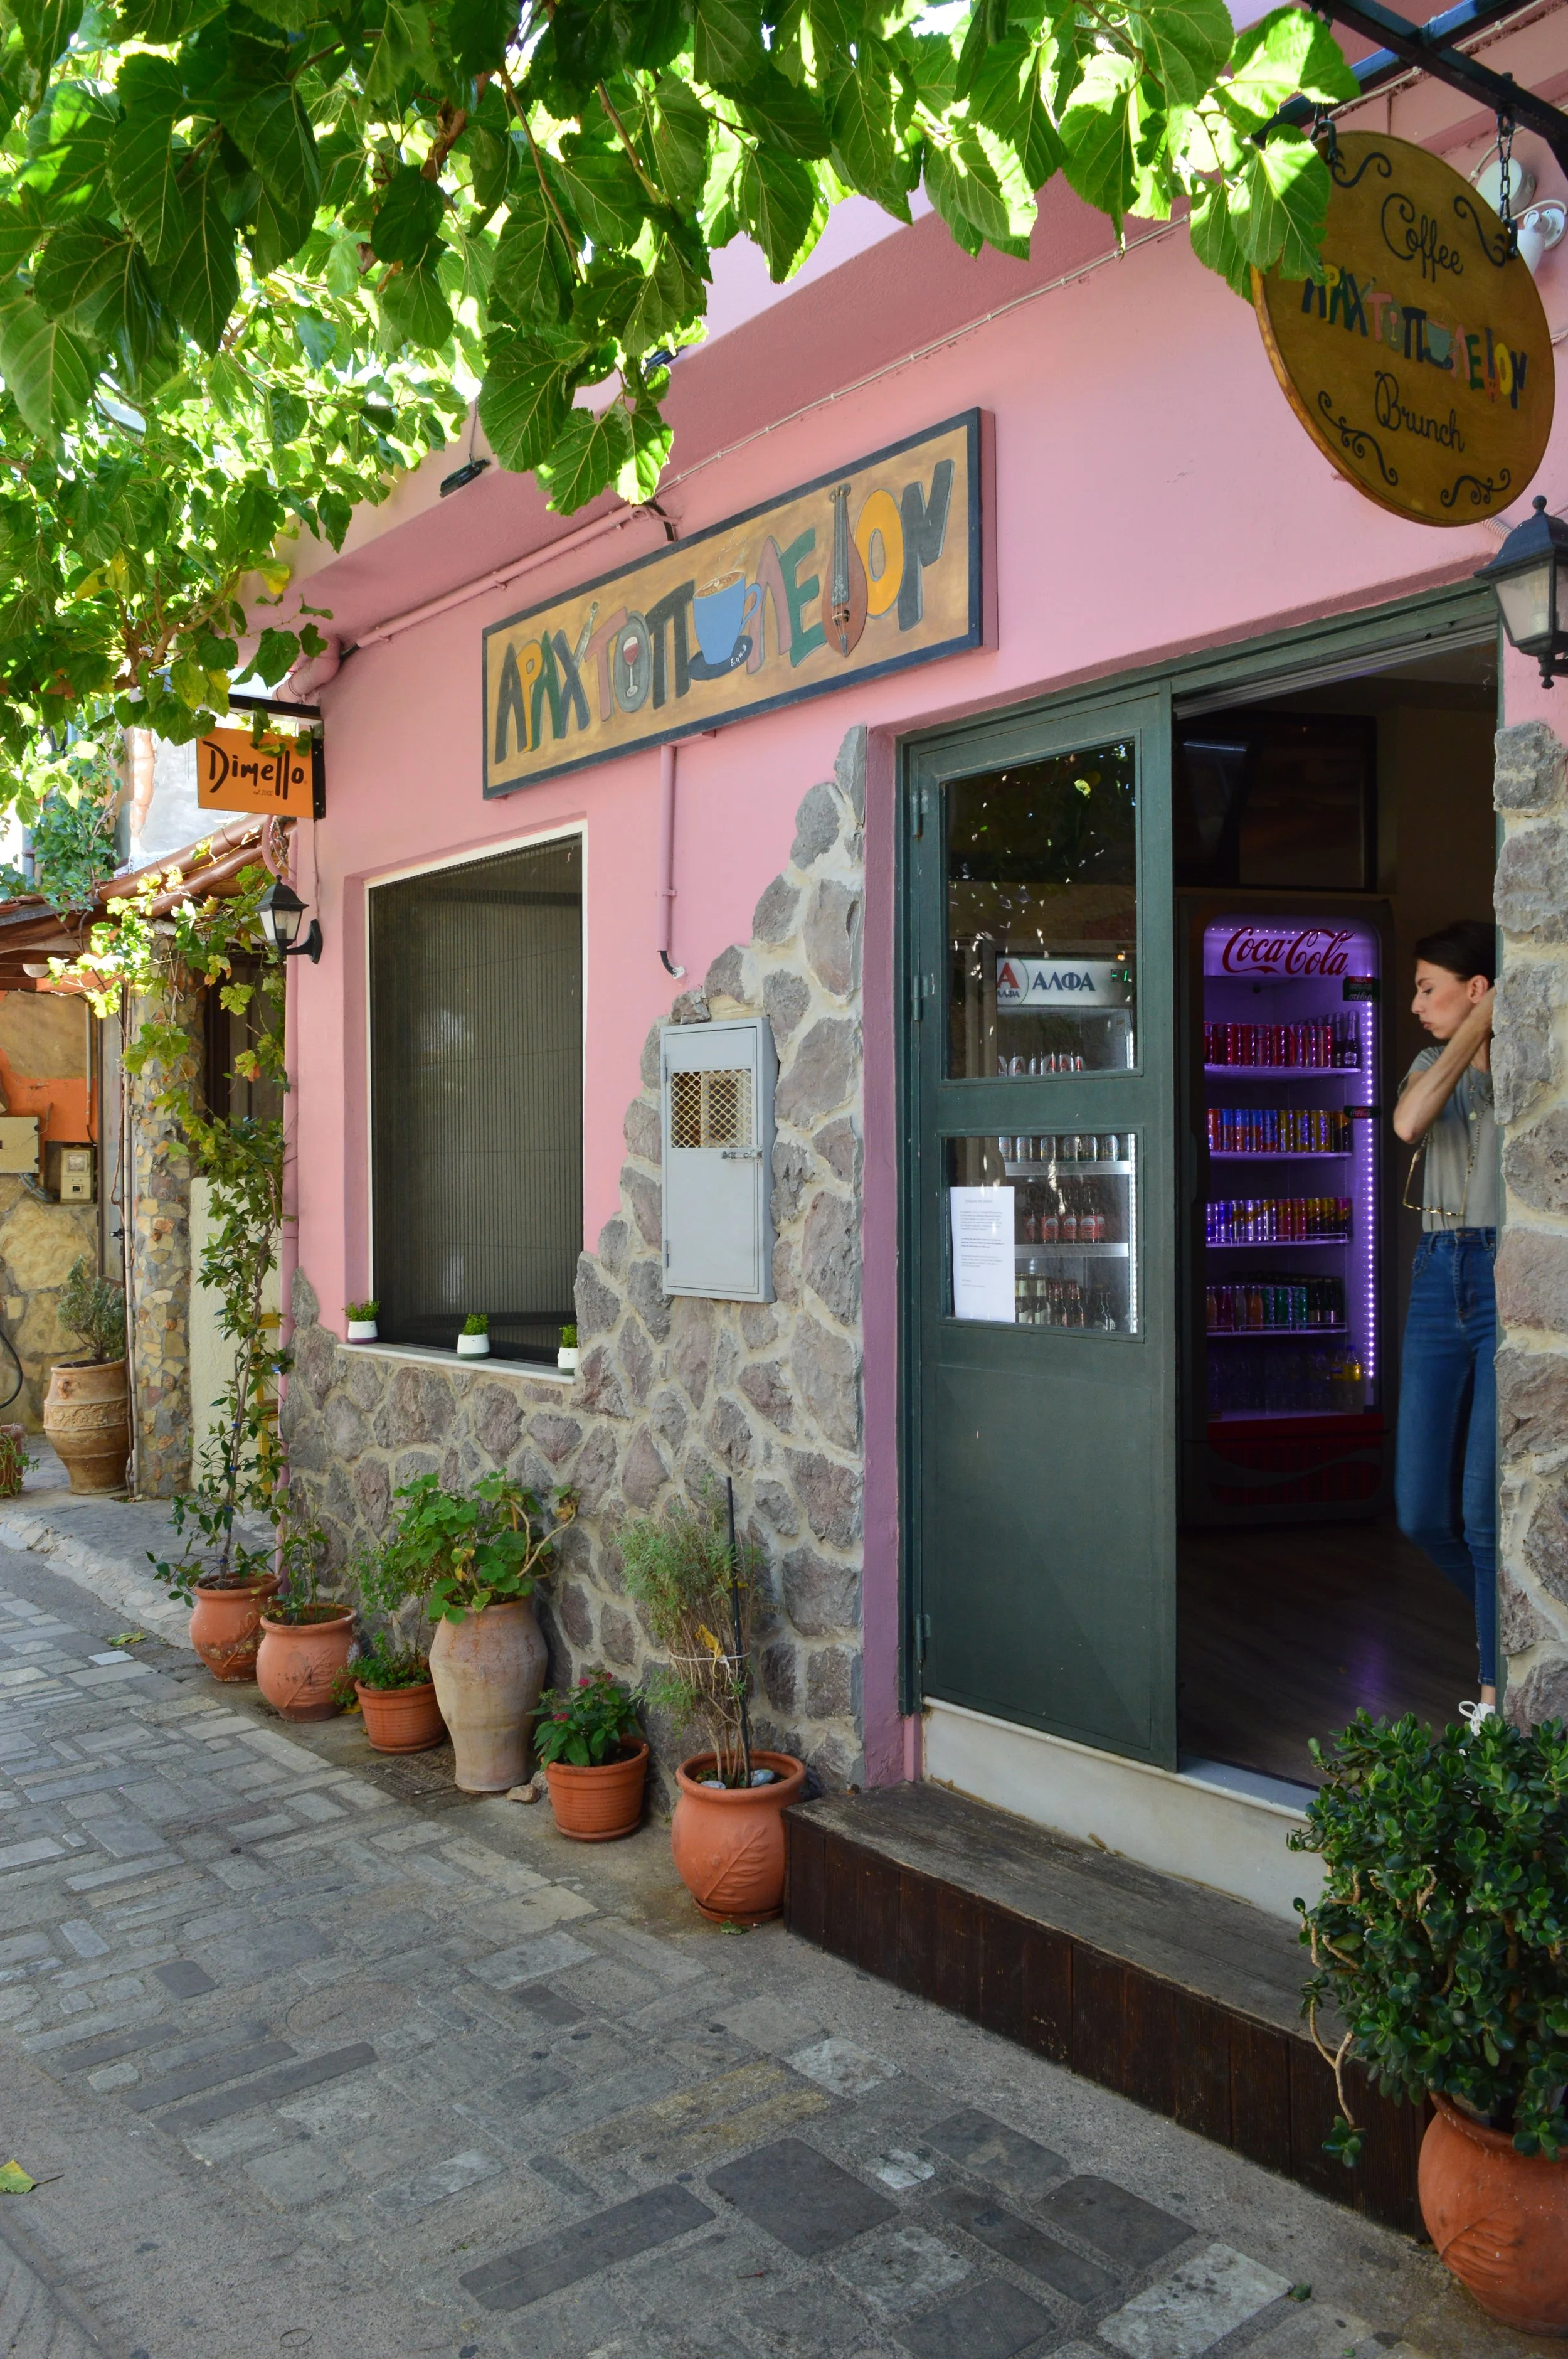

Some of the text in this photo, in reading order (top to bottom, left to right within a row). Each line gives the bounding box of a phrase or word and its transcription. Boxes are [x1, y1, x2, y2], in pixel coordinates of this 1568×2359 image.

[1381, 193, 1464, 284] Coffee
[1375, 371, 1465, 452] Brunch
[202, 740, 305, 801] Dimello
[1032, 971, 1096, 991] ΑΛΦΑ
[1222, 926, 1356, 976] Coca-Cola
